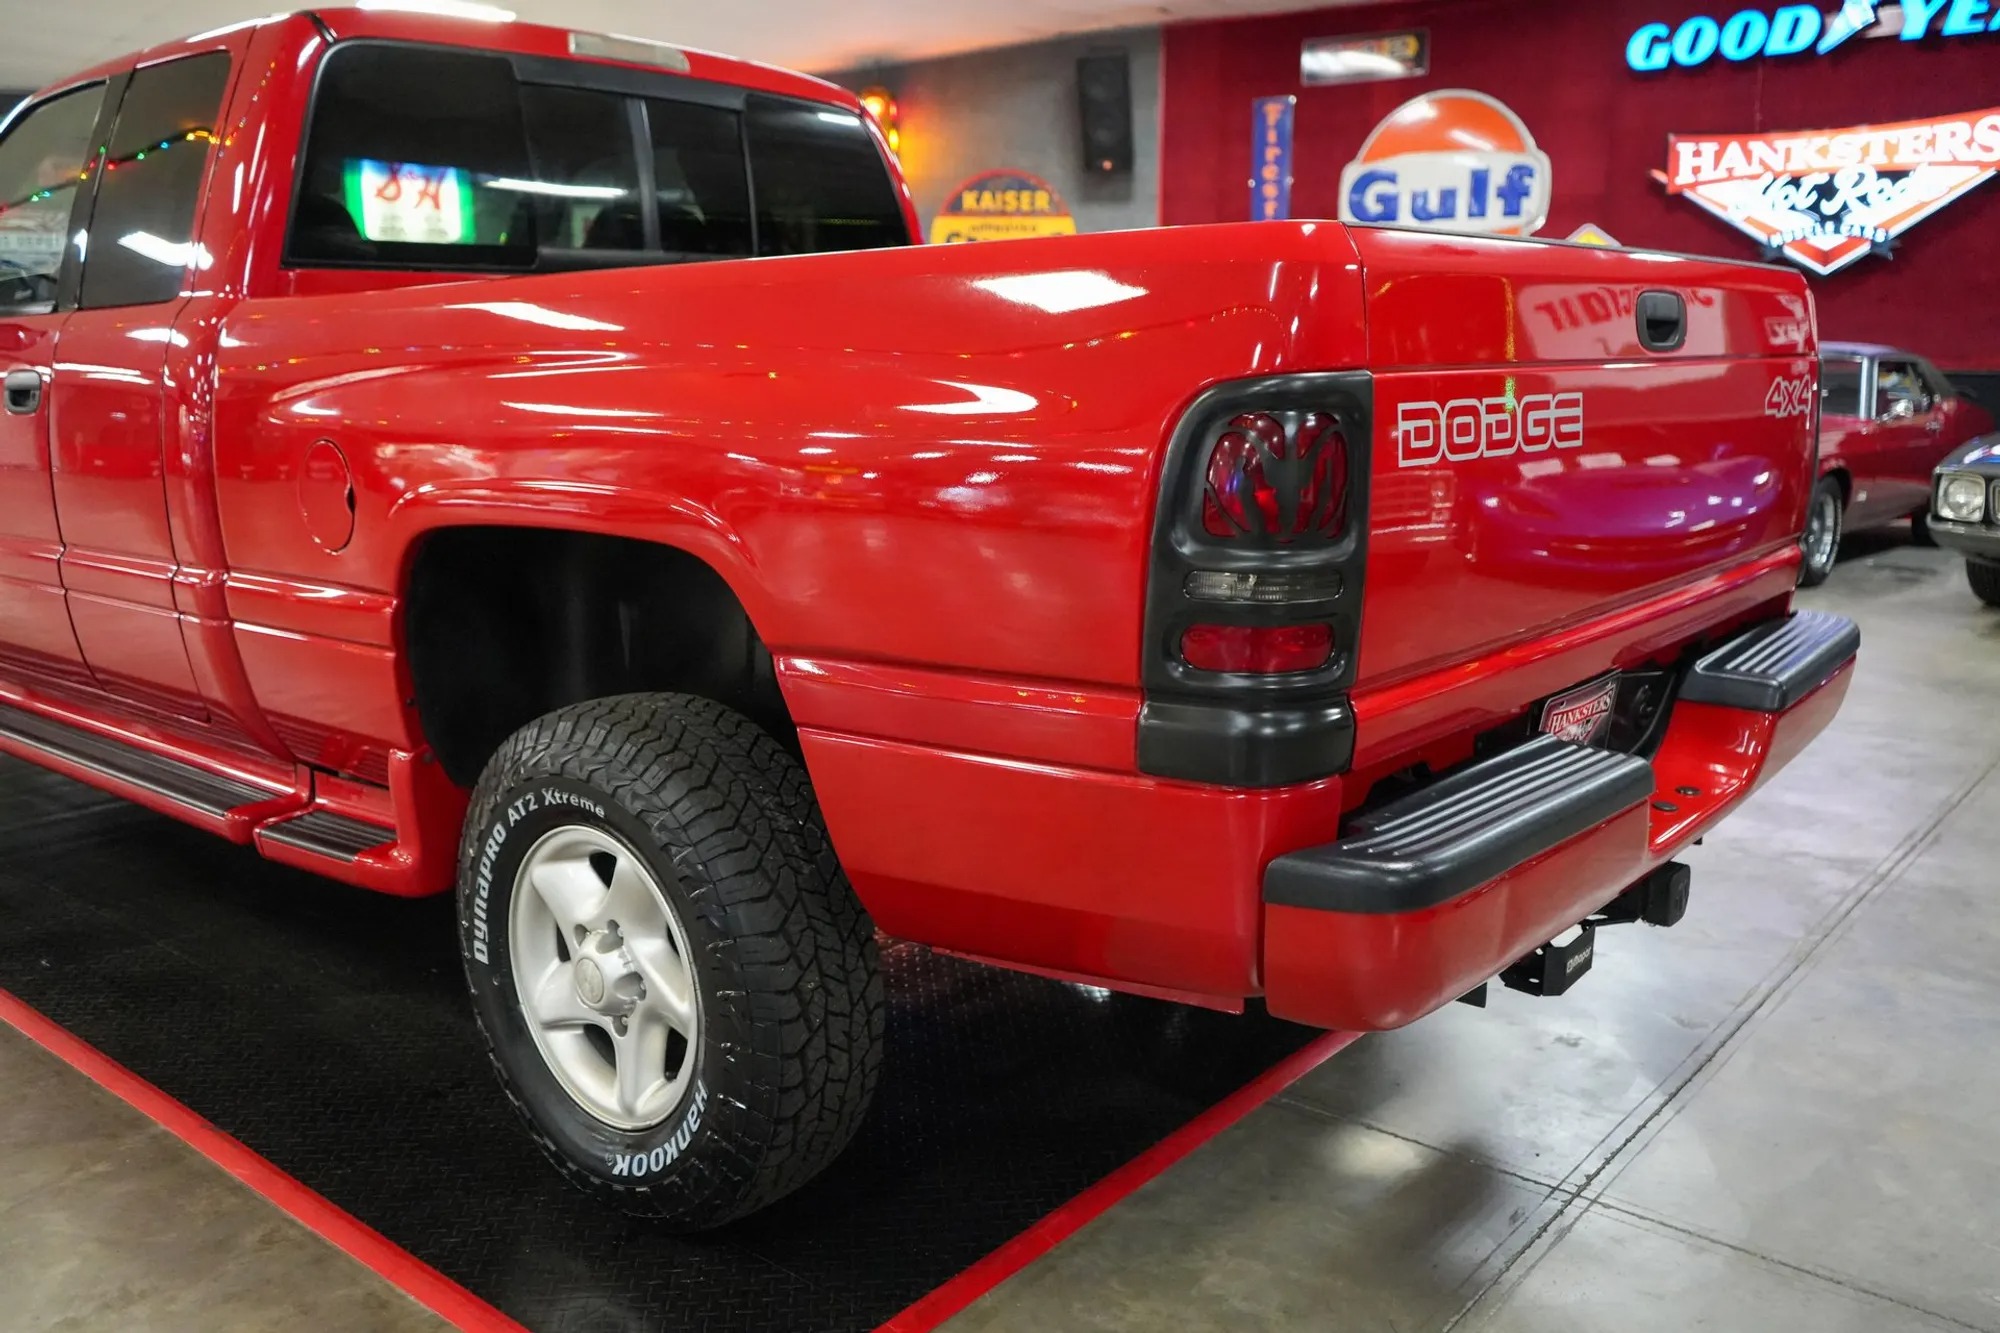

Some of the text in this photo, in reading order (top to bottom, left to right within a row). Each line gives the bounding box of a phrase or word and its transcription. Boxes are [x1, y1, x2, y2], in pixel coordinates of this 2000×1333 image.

[1625, 0, 2000, 71] GOOD YE
[1675, 114, 2000, 185] HANKSTERS
[961, 188, 1051, 212] KAISER
[1349, 164, 1534, 222] Gulf
[1398, 392, 1583, 467] DODGE
[1551, 691, 1613, 733] HANKSTERS
[507, 792, 539, 827] AT2
[541, 787, 606, 818] Xtreme
